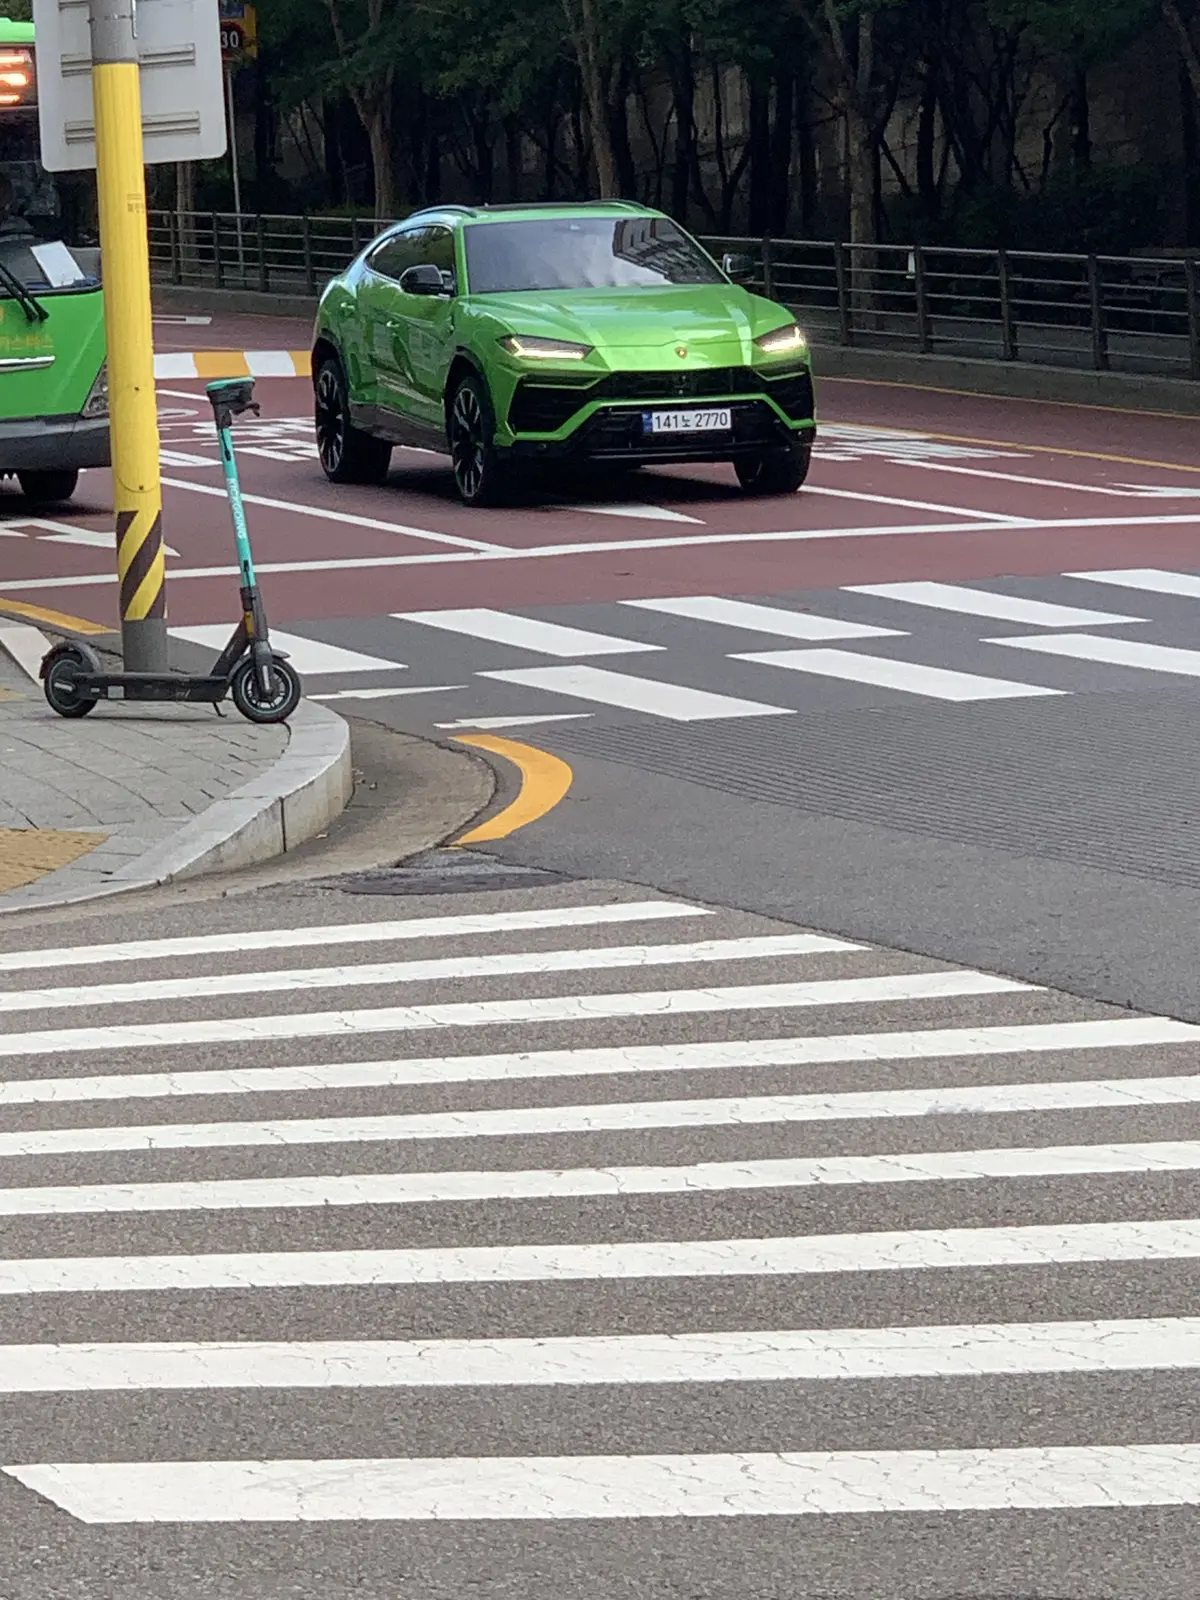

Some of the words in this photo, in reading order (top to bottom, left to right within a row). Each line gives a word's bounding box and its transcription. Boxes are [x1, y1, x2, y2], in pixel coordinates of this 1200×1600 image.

[221, 30, 239, 49] 30
[655, 414, 691, 429] 141노
[694, 411, 729, 428] 2770
[227, 478, 247, 539] KICKGOING
